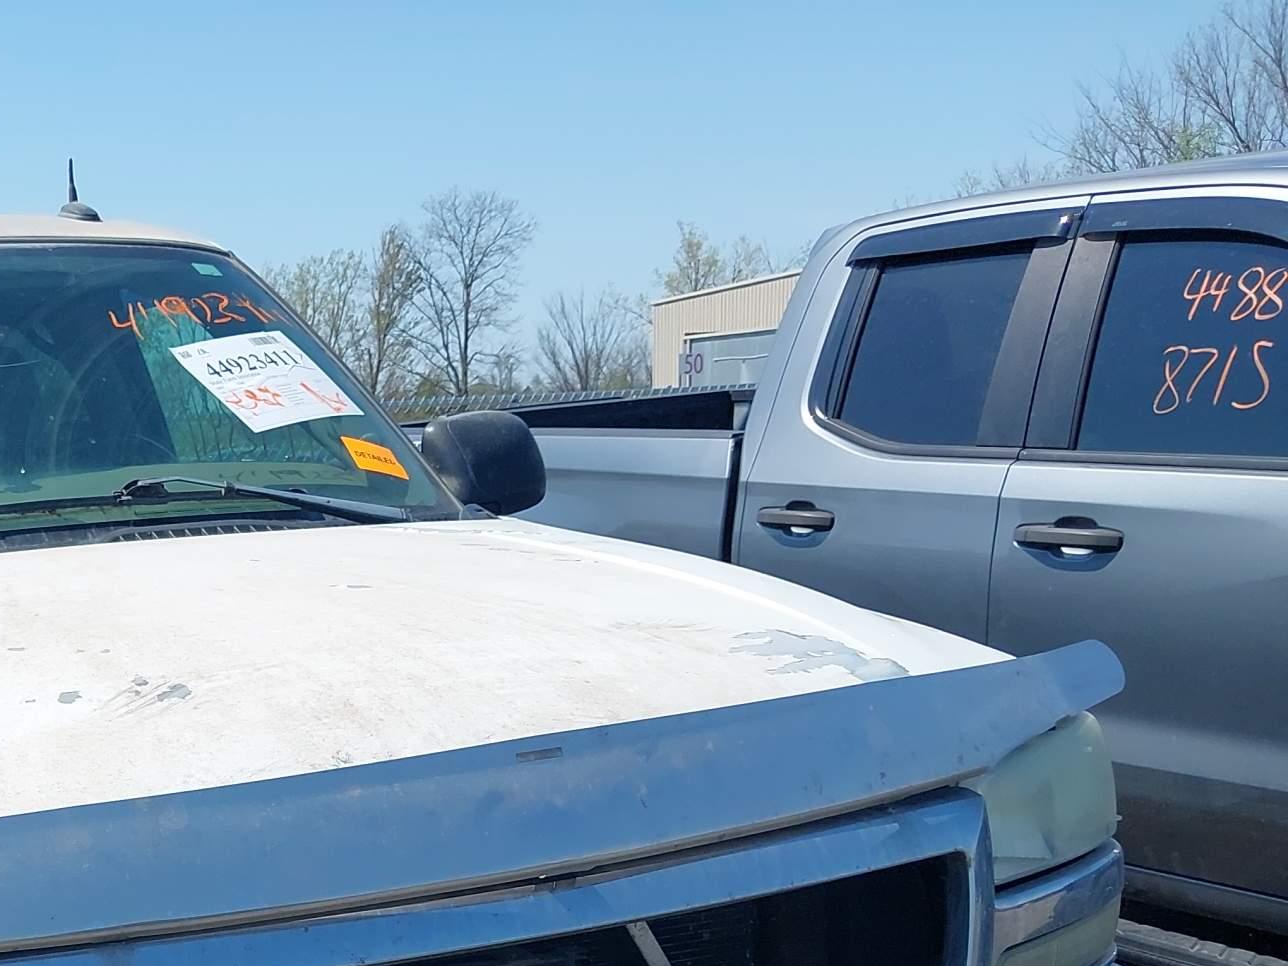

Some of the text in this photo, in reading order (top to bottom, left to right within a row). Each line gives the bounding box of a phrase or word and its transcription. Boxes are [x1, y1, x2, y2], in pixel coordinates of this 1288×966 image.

[1183, 266, 1288, 321] 4488
[206, 350, 301, 378] 44923411
[683, 353, 704, 374] 50
[1153, 340, 1274, 414] 8715
